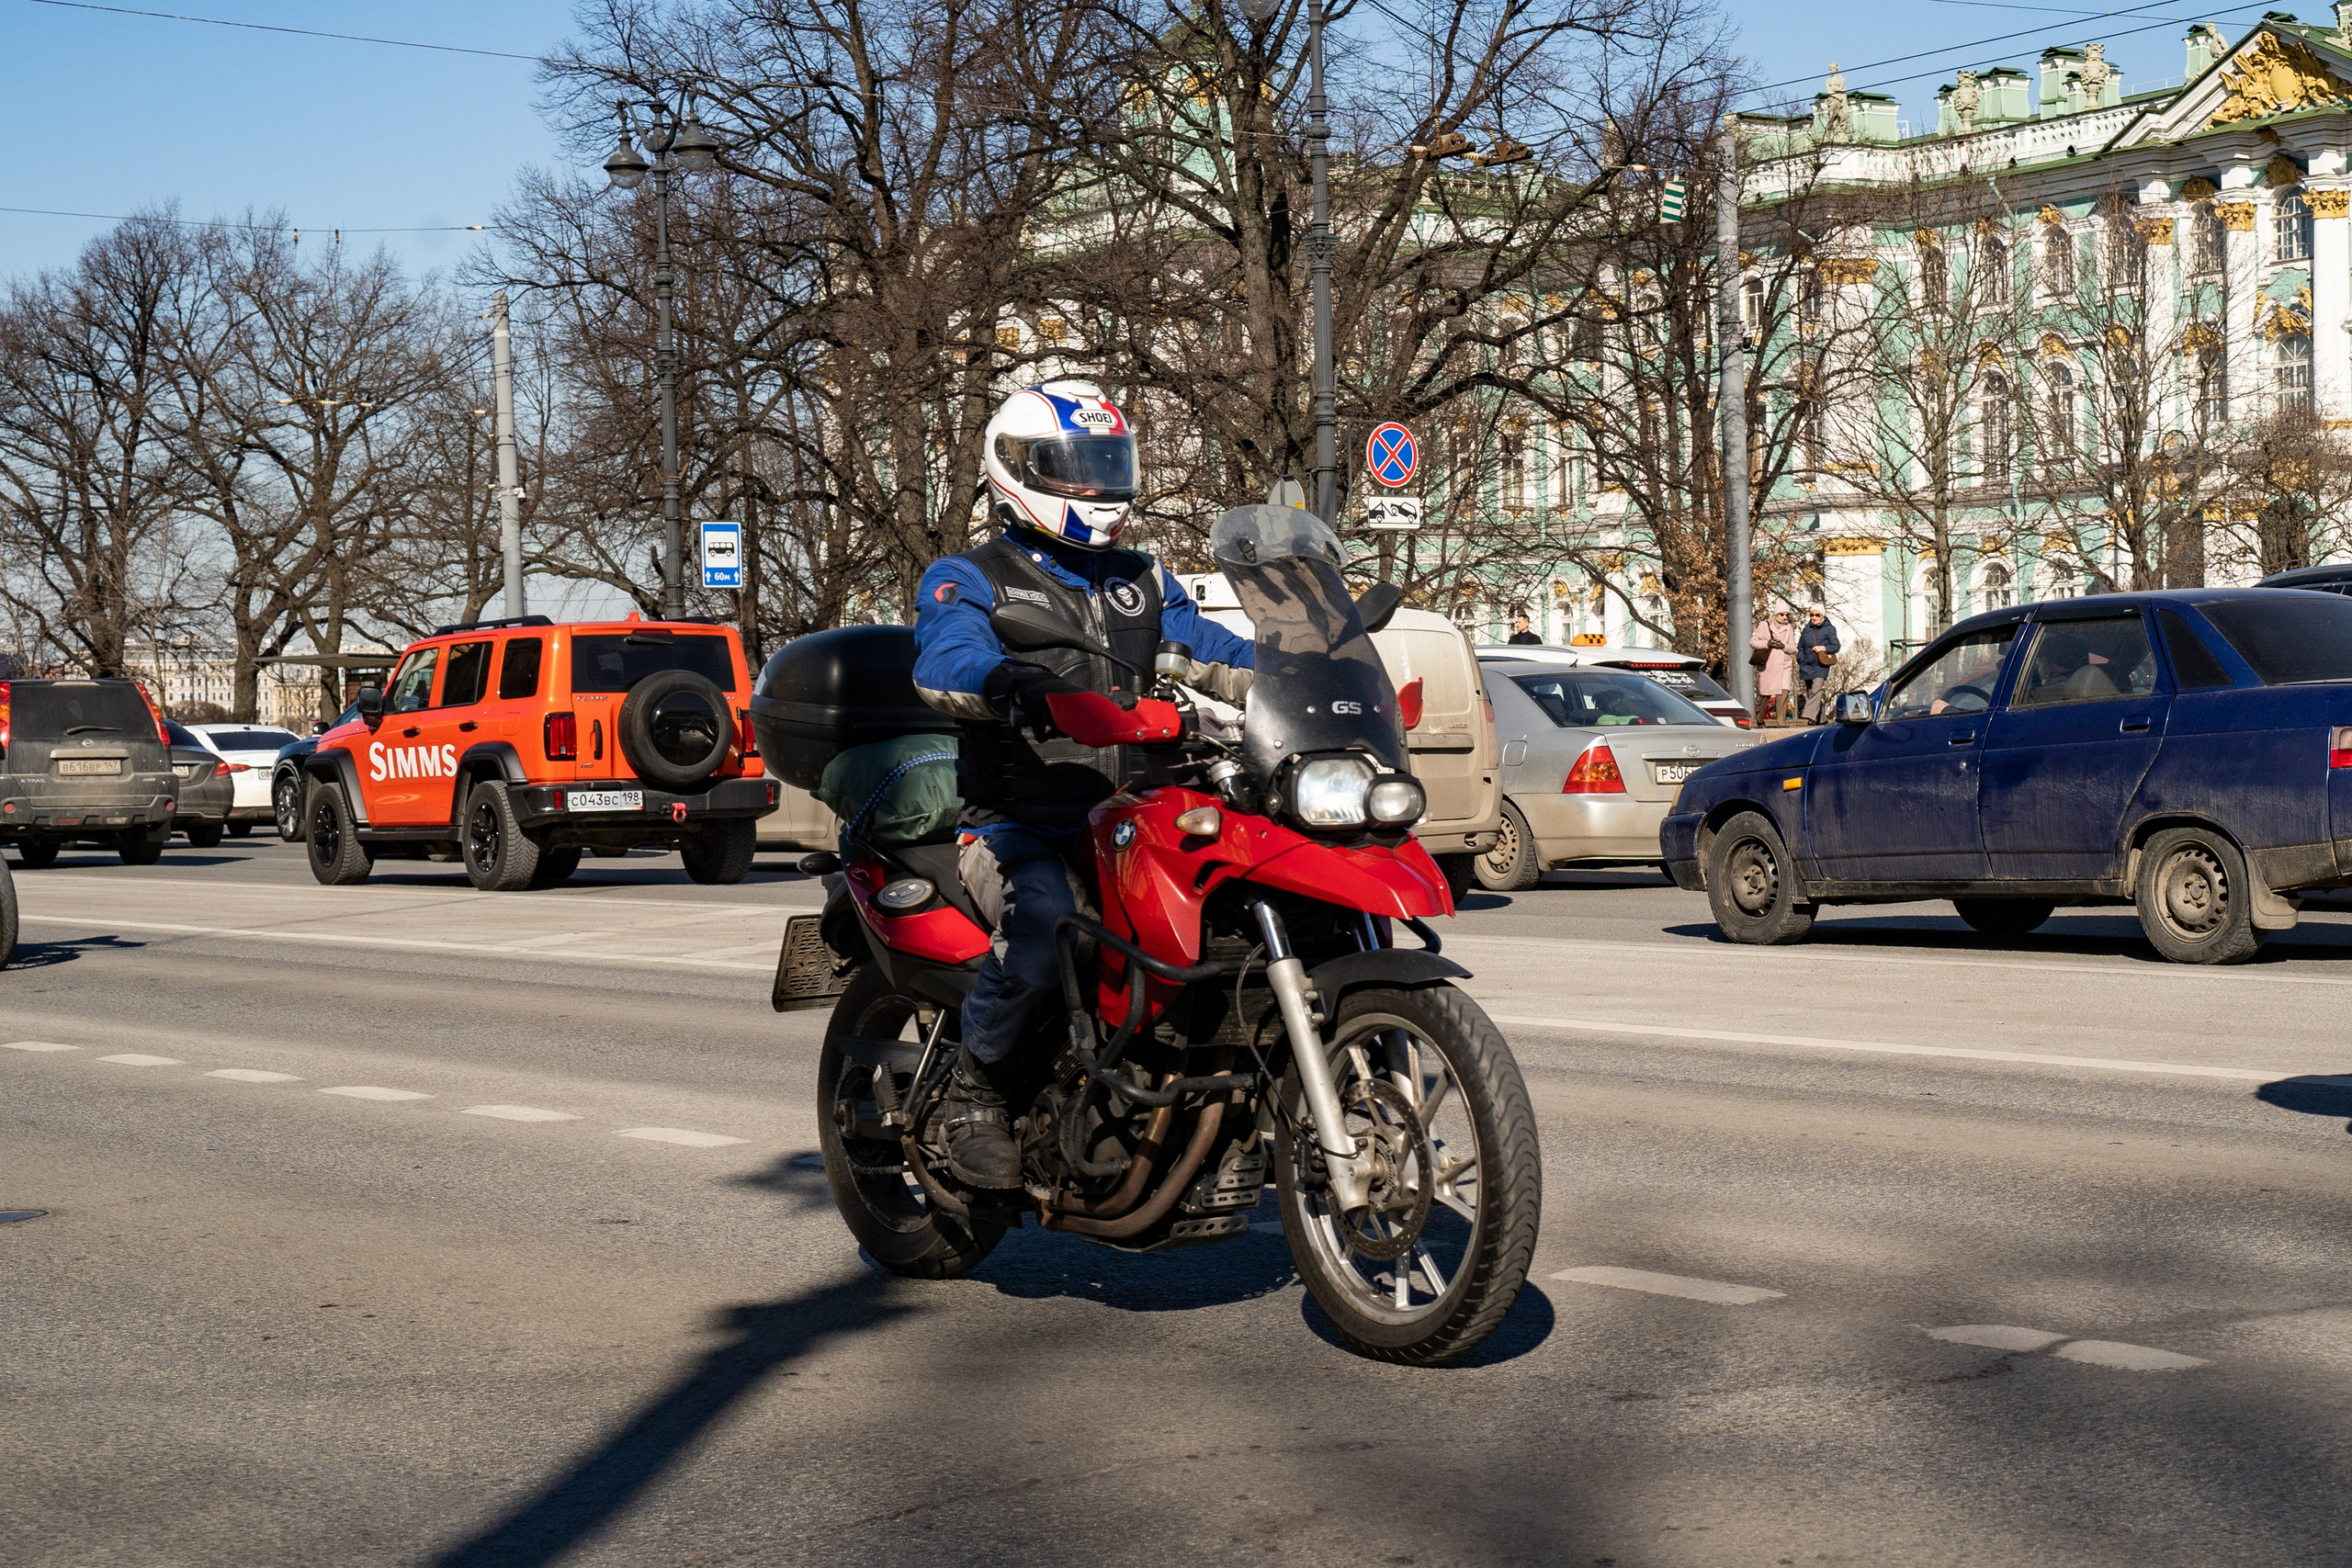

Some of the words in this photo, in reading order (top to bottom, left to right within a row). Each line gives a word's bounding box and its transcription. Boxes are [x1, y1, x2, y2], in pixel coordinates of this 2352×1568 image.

[1079, 412, 1113, 423] SHOEI
[714, 571, 731, 581] 60м
[1331, 700, 1362, 716] GS
[368, 740, 458, 782] SIMMS
[621, 792, 639, 802] 198
